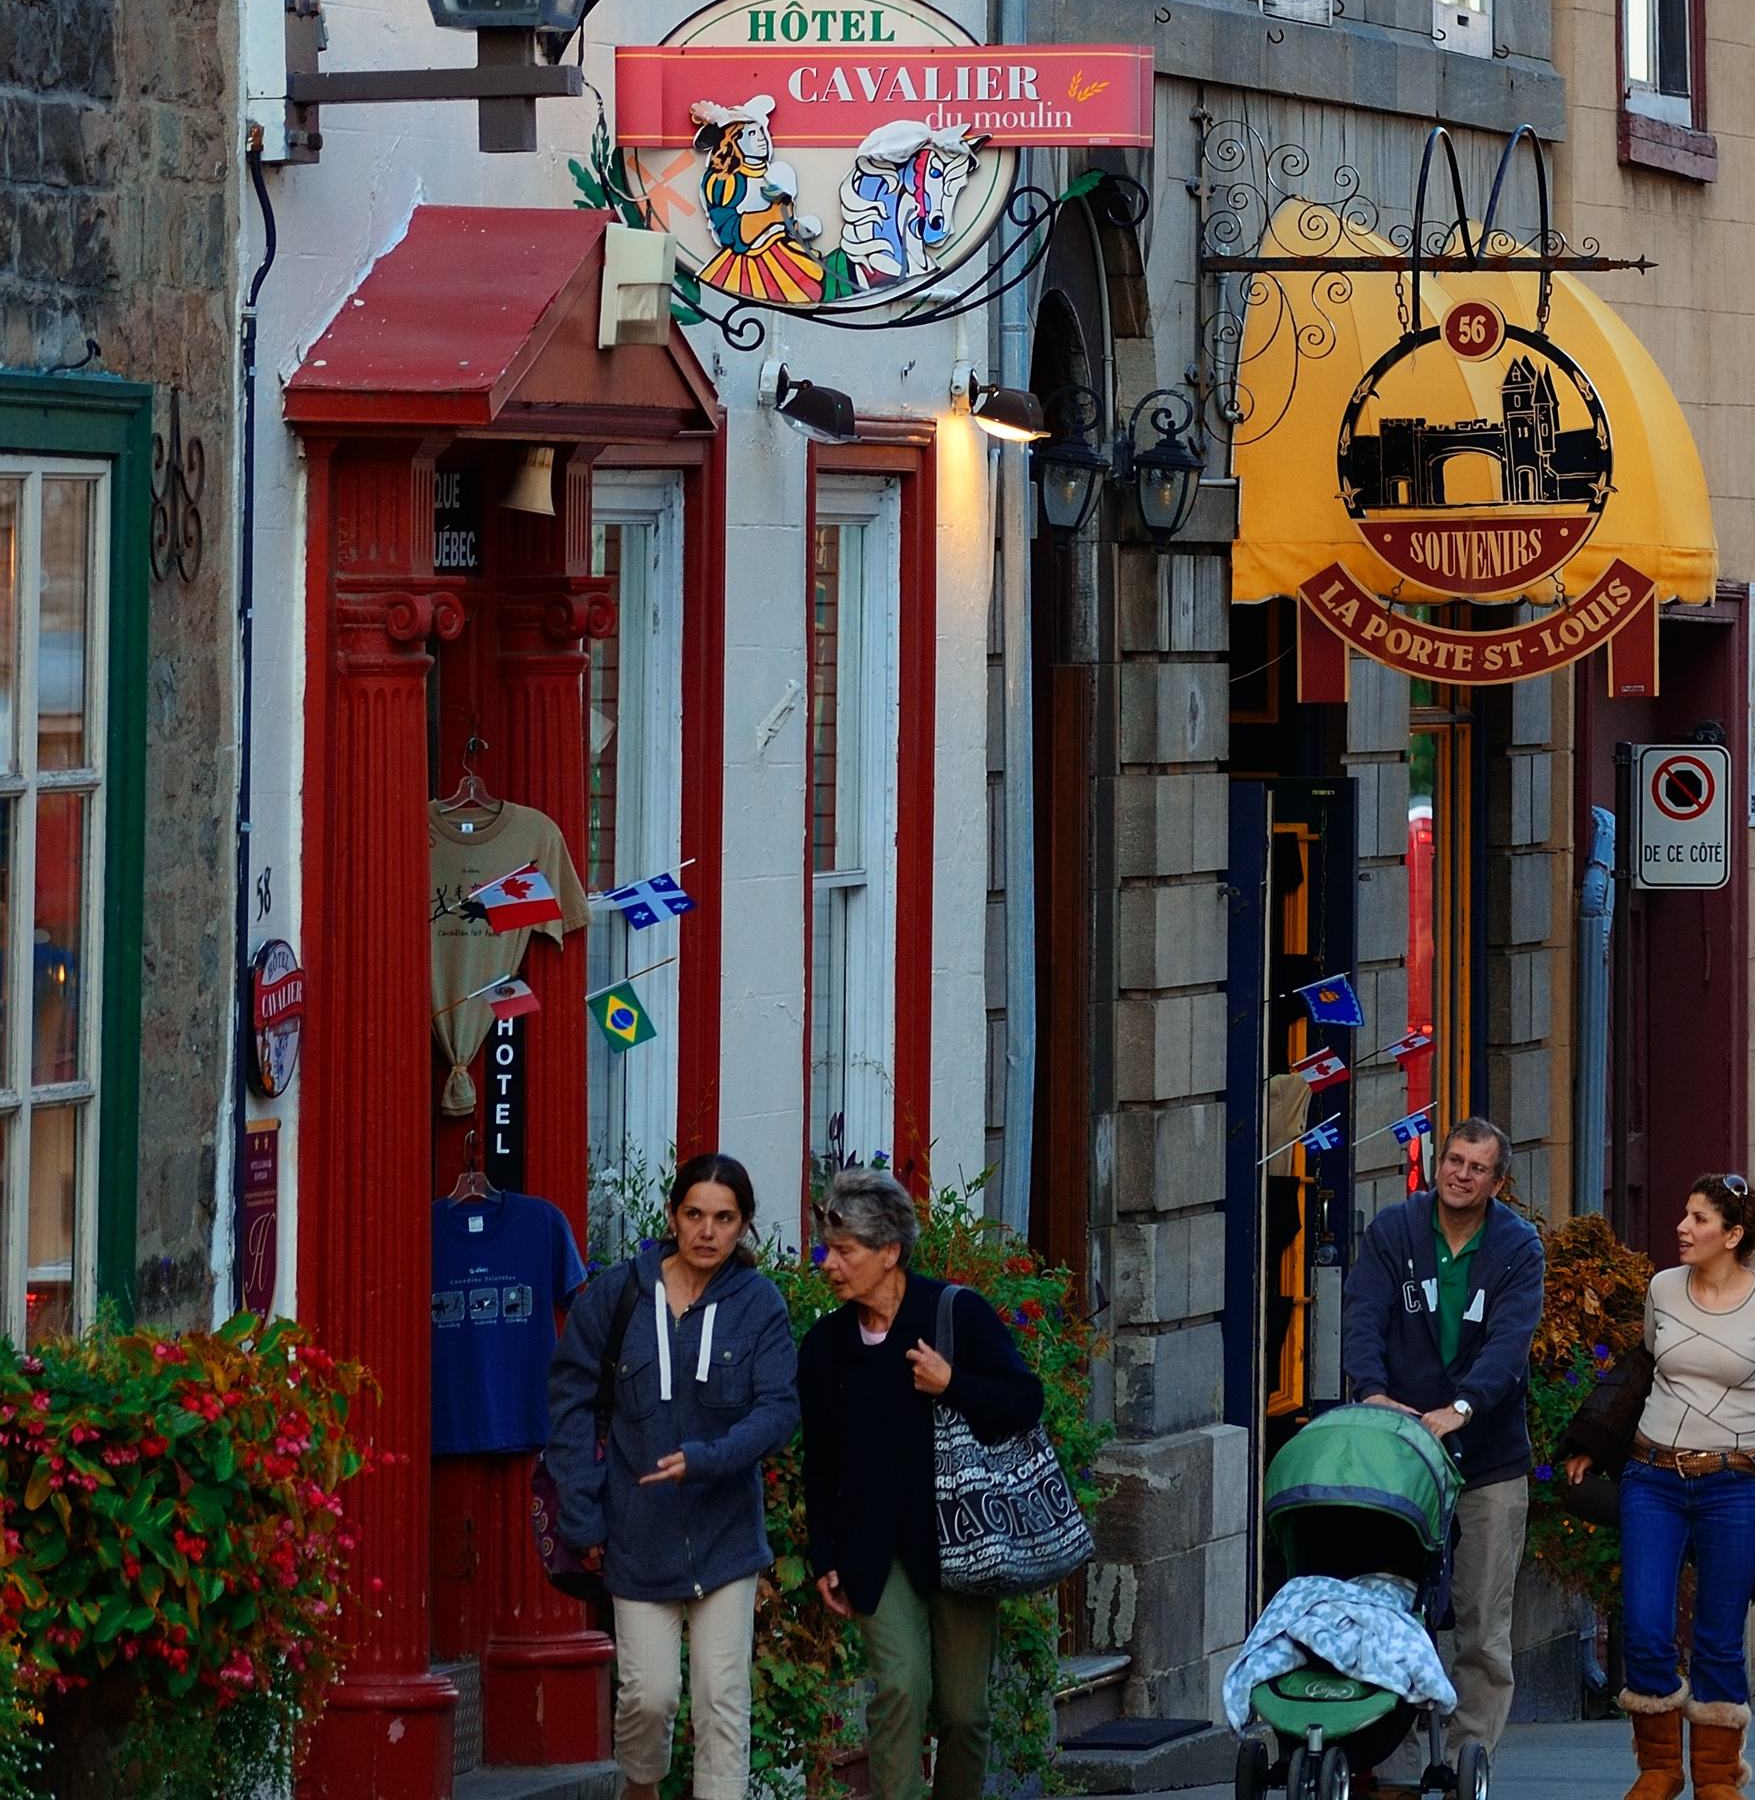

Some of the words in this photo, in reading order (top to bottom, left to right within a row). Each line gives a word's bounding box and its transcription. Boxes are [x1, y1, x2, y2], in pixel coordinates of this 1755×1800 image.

[748, 1, 896, 43] HÔTEL
[788, 65, 1041, 103] CAVALIER
[925, 103, 963, 129] du
[969, 101, 1073, 128] moulin
[1457, 314, 1486, 345] 56
[1409, 526, 1543, 582] SOUVENIRS
[1319, 578, 1358, 629] LA
[1361, 613, 1474, 673] PORTE
[1644, 845, 1661, 862] DE
[1667, 845, 1684, 862] CE
[1690, 841, 1722, 862] CÔTÉ
[257, 866, 272, 923] 58
[267, 950, 291, 981] HÔTEL
[261, 979, 303, 1019] CAVALIER
[495, 1016, 513, 1154] HOTEL
